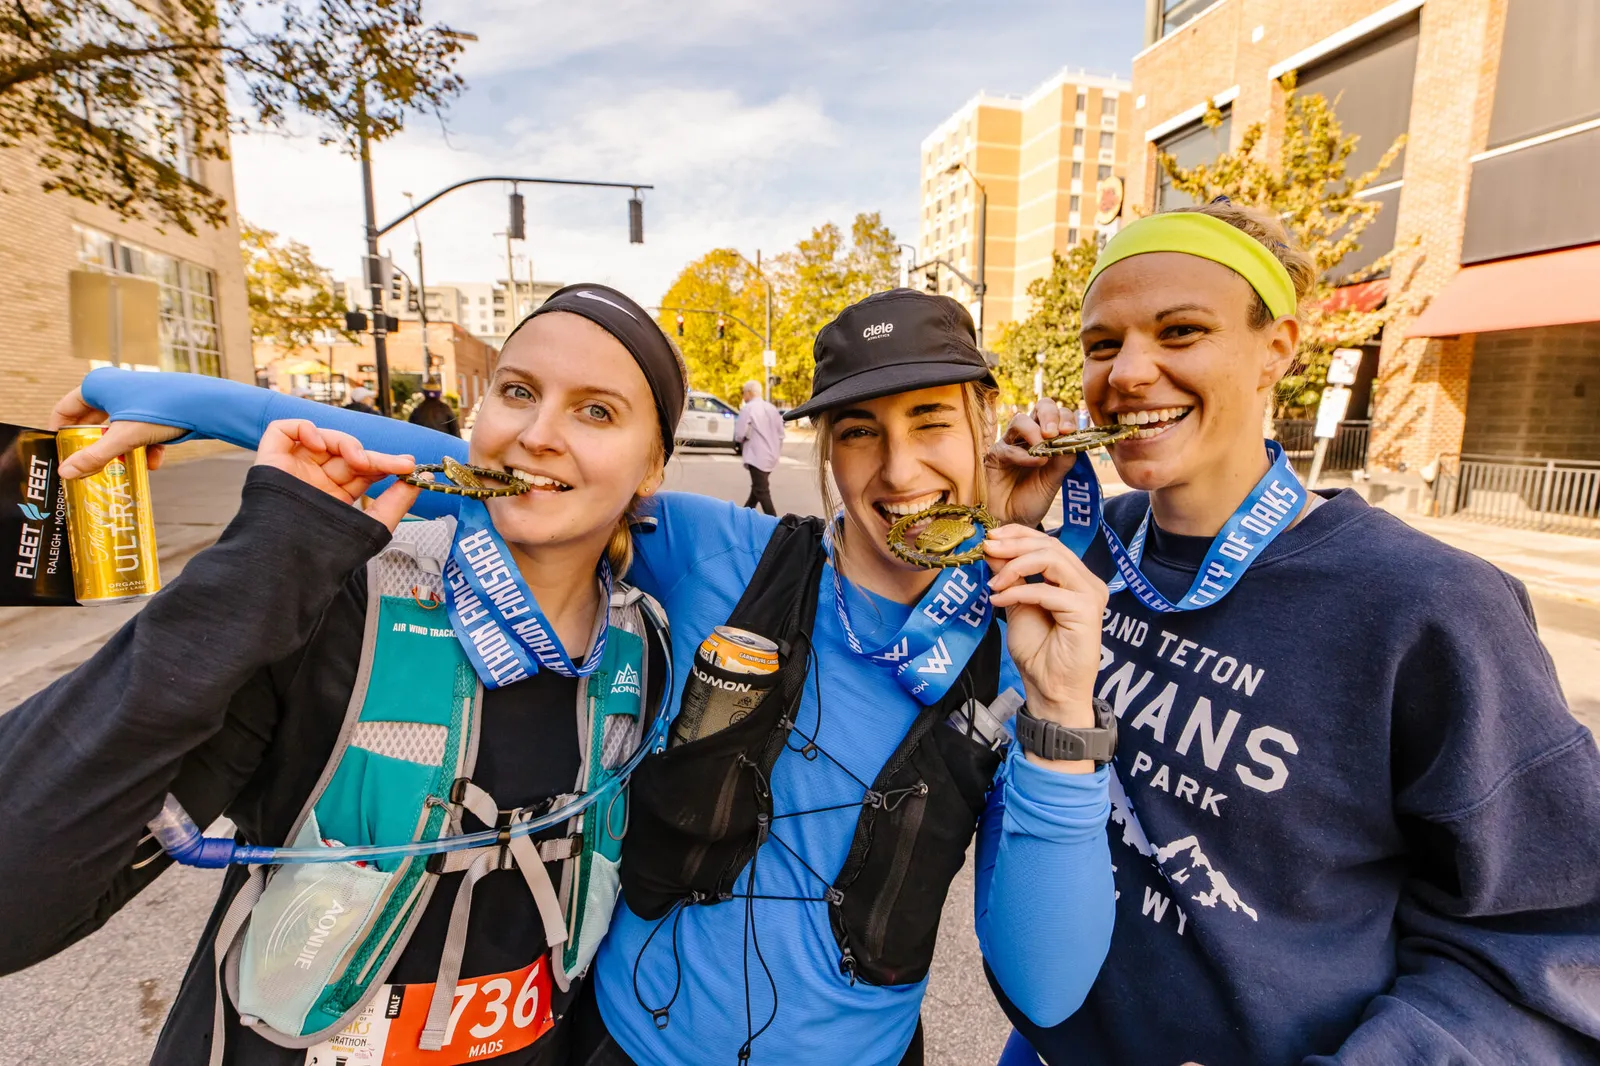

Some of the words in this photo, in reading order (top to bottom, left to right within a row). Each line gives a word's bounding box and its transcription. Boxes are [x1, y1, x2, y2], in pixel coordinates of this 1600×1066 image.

[27, 454, 49, 501] FEET
[54, 478, 66, 526] MORRIS
[1067, 478, 1091, 527] 2023
[15, 523, 41, 579] FLEET
[47, 533, 62, 575] RALEIGH
[109, 480, 140, 573] ULTRA
[1189, 561, 1233, 606] CITY
[1219, 531, 1255, 562] OF
[1240, 479, 1299, 537] OAKS
[458, 529, 530, 620] FINISHER
[923, 567, 978, 625] 2023
[393, 623, 406, 632] AIR
[409, 624, 428, 635] WIND
[430, 628, 457, 638] TRACK
[469, 619, 529, 688] ATHON
[692, 664, 752, 693] LOMON
[1156, 630, 1265, 697] TETON
[1130, 750, 1228, 817] PARK
[294, 899, 345, 970] AONIJIE
[1141, 886, 1188, 936] WY
[388, 994, 401, 1016] HALF
[442, 963, 540, 1047] 736
[468, 1039, 504, 1058] MADS
